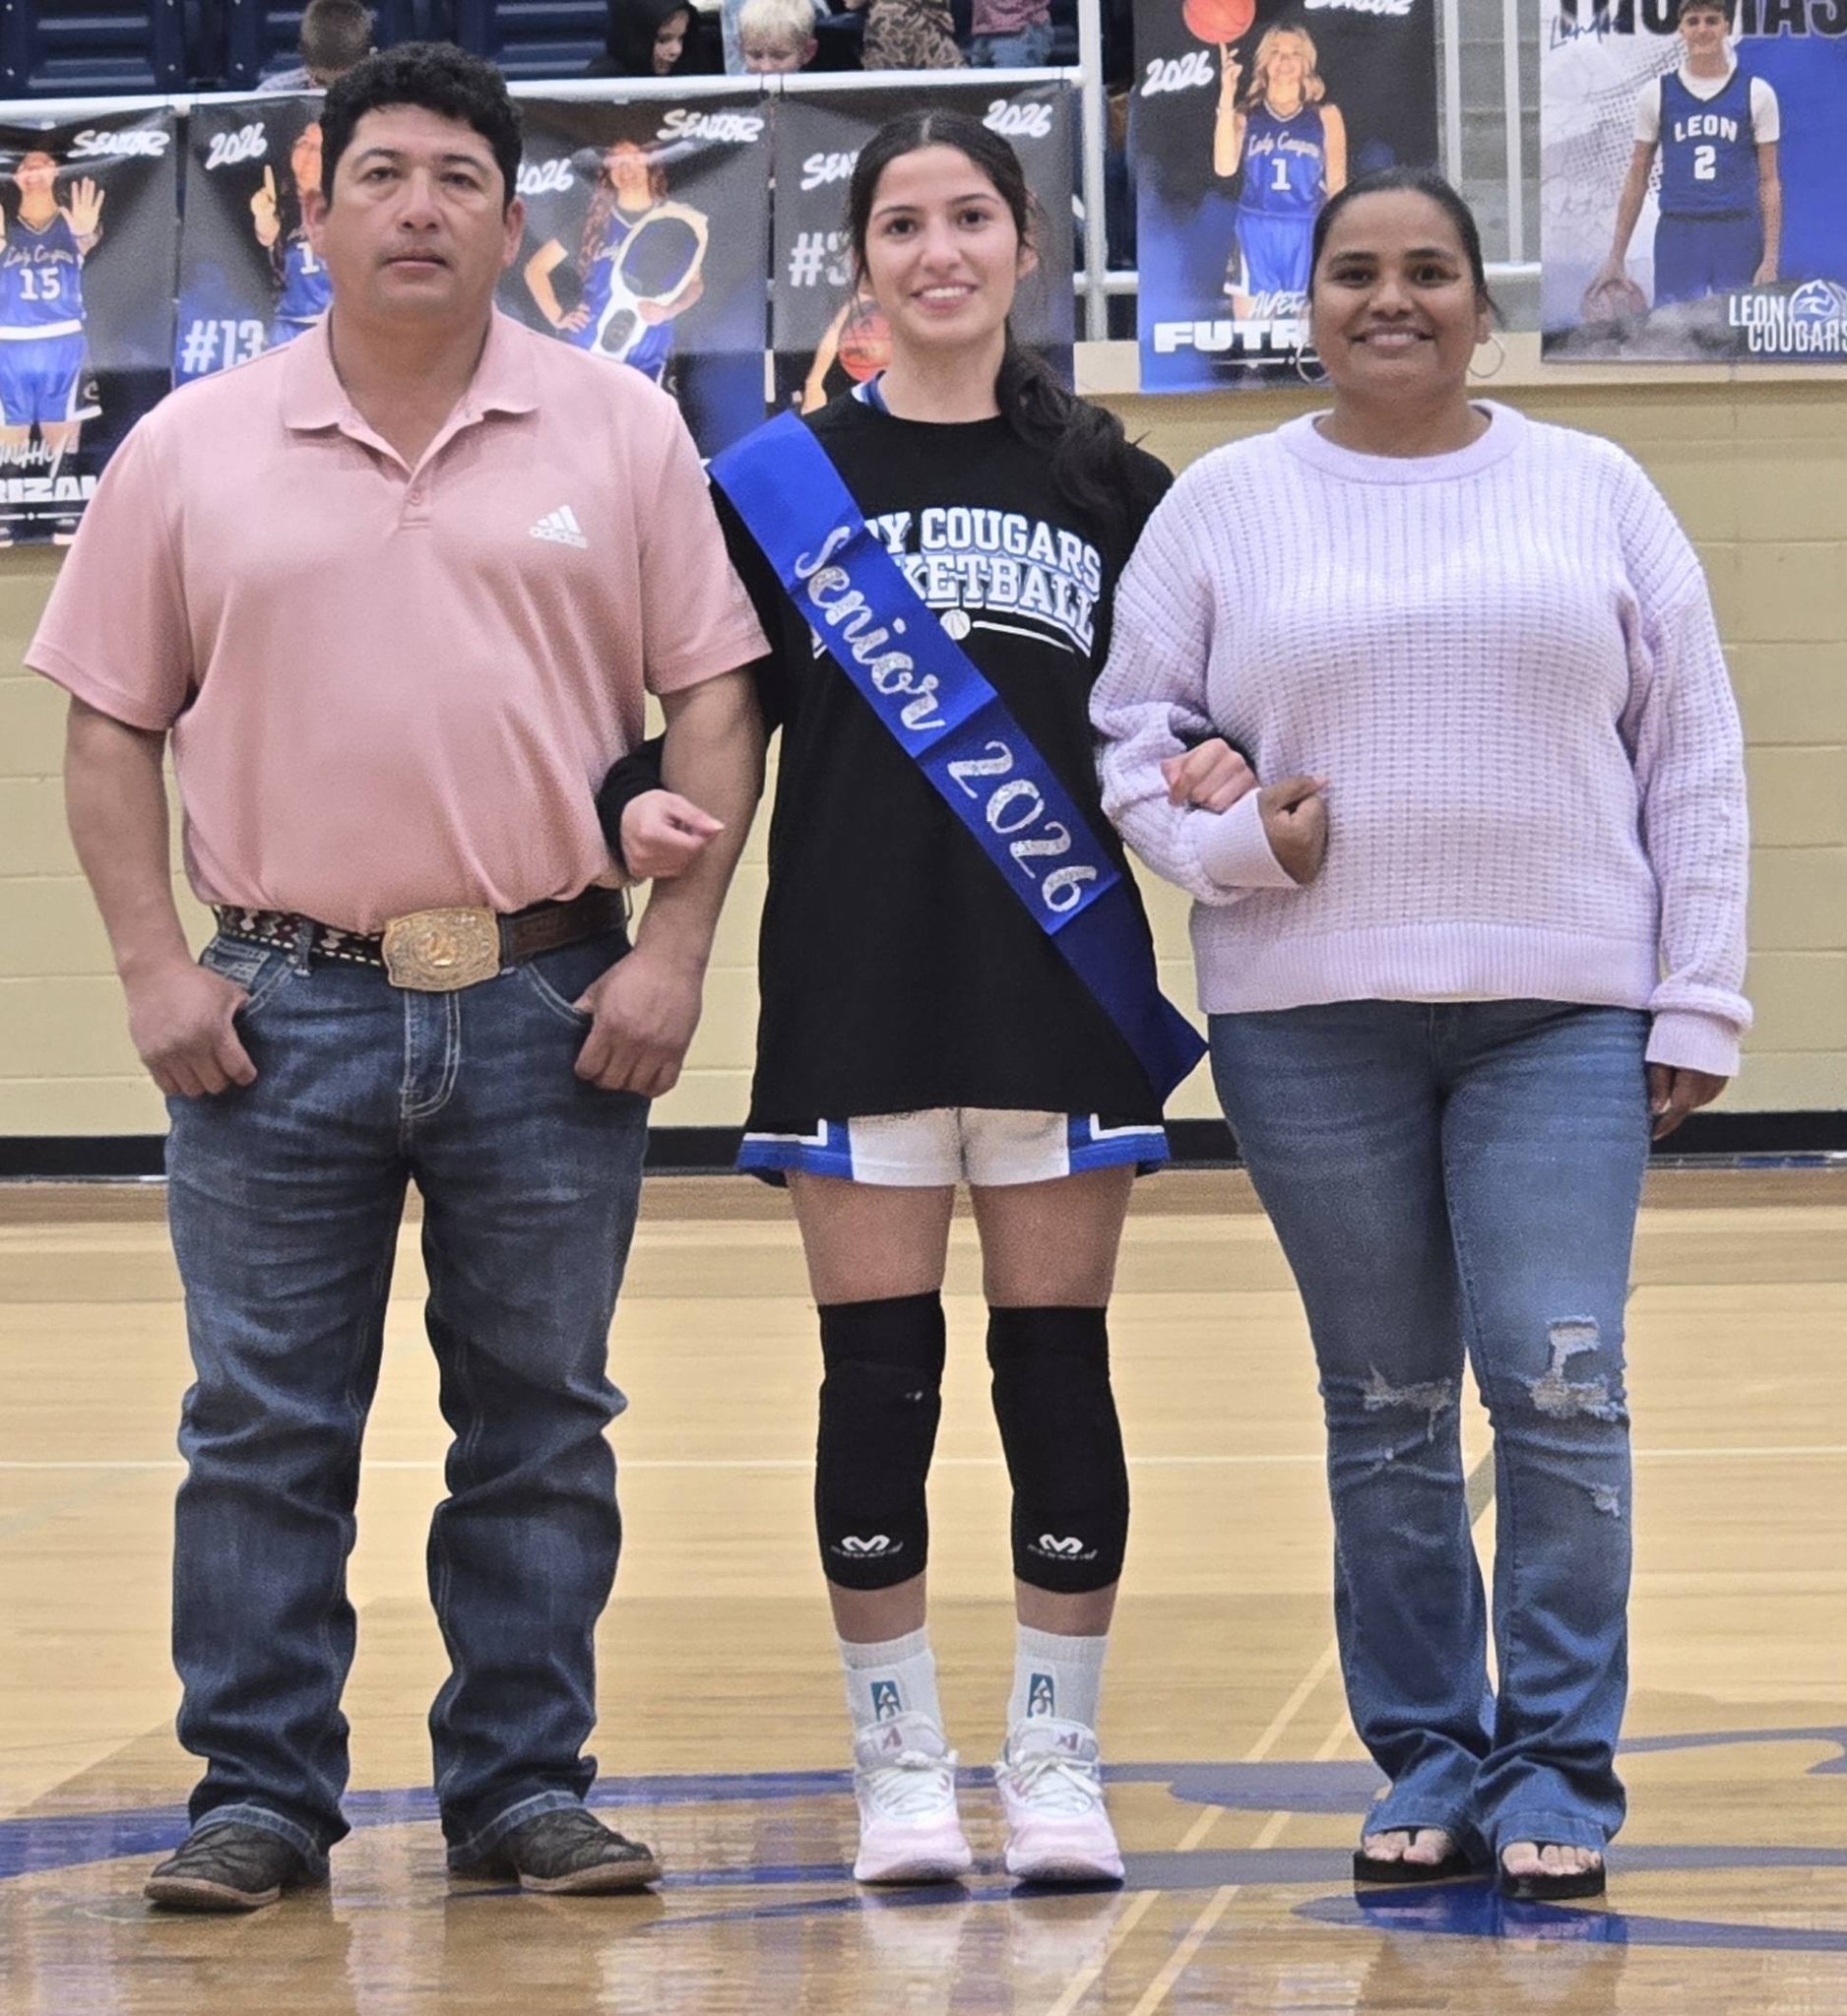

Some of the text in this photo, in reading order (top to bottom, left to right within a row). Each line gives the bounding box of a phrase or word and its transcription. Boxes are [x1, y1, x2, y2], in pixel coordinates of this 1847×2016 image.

[1140, 50, 1215, 97] 2026
[657, 108, 765, 143] SENIOR
[983, 99, 1053, 138] 2026
[1674, 114, 1739, 143] LEON
[66, 129, 171, 158] SENIOR
[204, 121, 268, 170] 2026
[1270, 158, 1292, 191] 1
[1693, 145, 1716, 180] 2
[19, 266, 61, 301] 15
[1729, 294, 1788, 327] LEON
[181, 319, 266, 374] #13
[1153, 318, 1314, 353] FUTR
[921, 507, 1103, 600] COUGARS
[898, 553, 1096, 647] KETBALL
[794, 525, 1098, 913] Senior 2026
